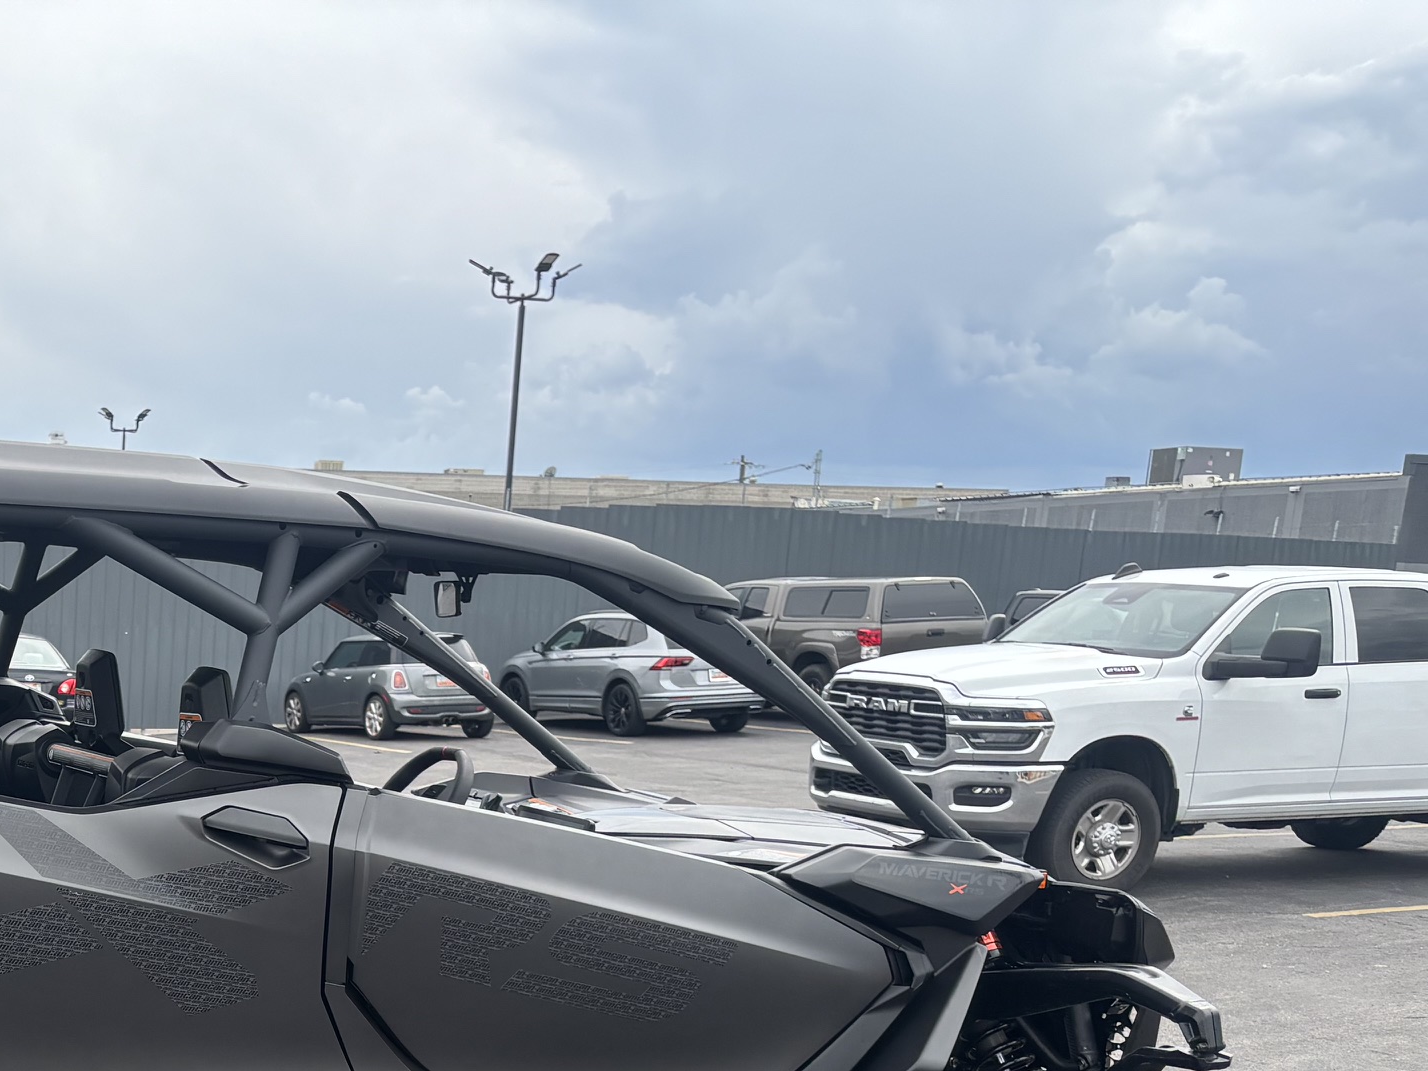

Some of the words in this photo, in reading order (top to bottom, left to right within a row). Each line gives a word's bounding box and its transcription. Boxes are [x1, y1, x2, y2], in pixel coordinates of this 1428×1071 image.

[846, 694, 909, 713] RAM
[878, 861, 984, 886] MAVERICK
[986, 873, 1009, 891] R
